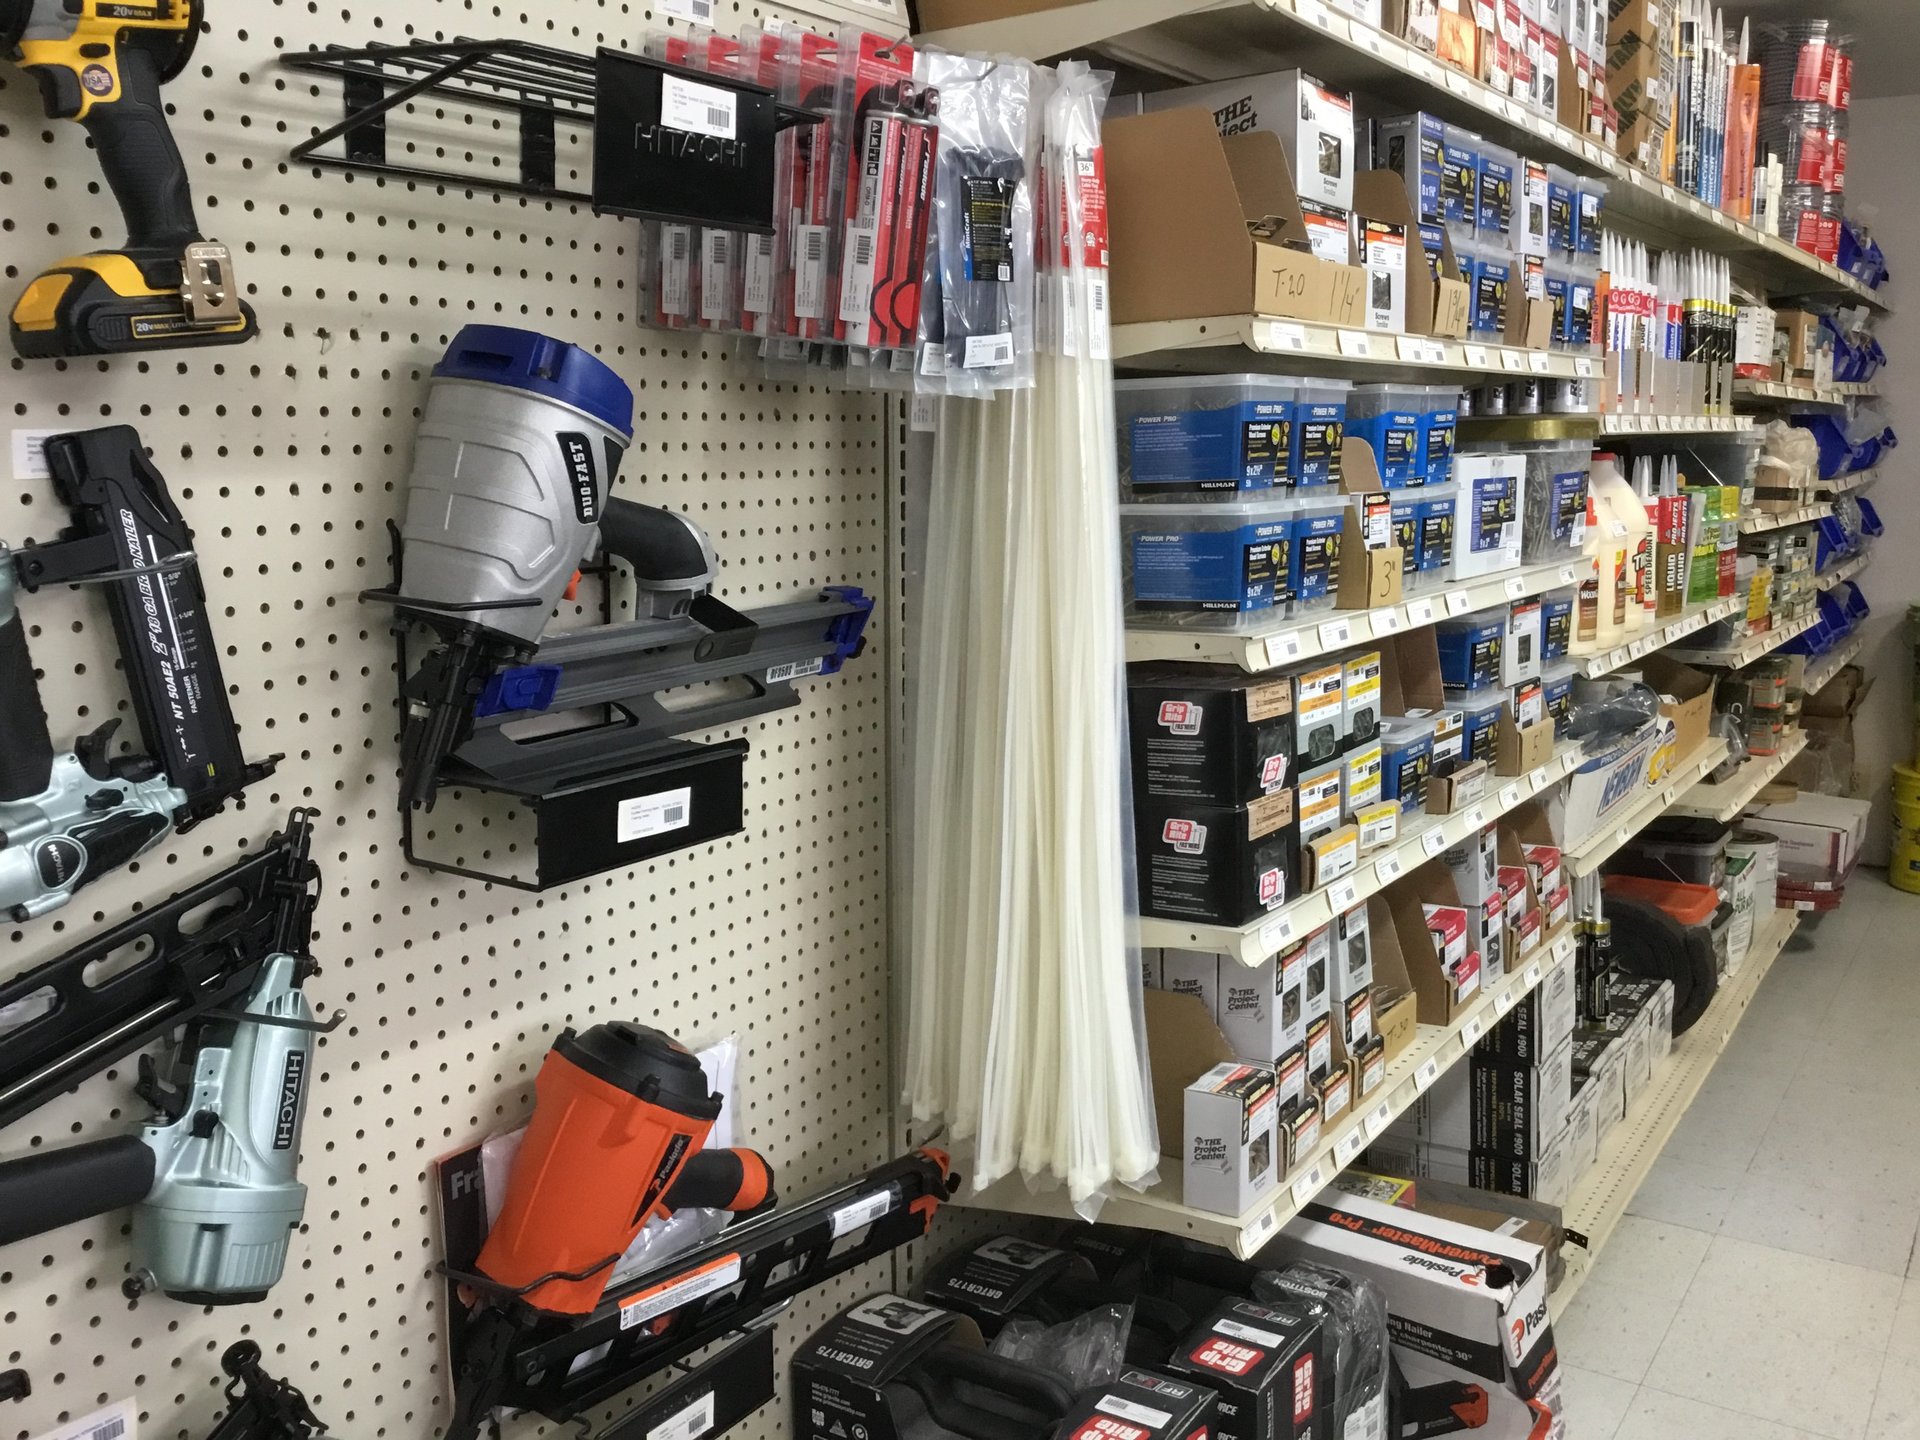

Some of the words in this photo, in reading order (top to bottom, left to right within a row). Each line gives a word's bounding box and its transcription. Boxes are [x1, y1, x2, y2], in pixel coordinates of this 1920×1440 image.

[86, 74, 102, 84] USA
[1213, 95, 1253, 127] THE
[1424, 116, 1434, 126] POWER
[1434, 120, 1442, 128] PRO
[634, 122, 747, 168] HITACHI
[1450, 148, 1461, 158] POWER
[1461, 152, 1470, 161] PRO
[1420, 230, 1430, 239] POWER
[1430, 232, 1440, 241] PRO
[1257, 405, 1272, 414] POWER
[1273, 404, 1282, 414] PRO
[1313, 407, 1327, 416] POWER
[1327, 407, 1337, 416] PRO
[1139, 416, 1162, 424] POWER
[1201, 481, 1235, 489] HILLMAN
[1257, 526, 1273, 537] POWER
[1272, 525, 1283, 535] PRO
[1312, 520, 1327, 529] POWER
[1327, 519, 1336, 528] PRO
[1671, 501, 1679, 546] PROJECTS
[120, 509, 141, 560] NAILER
[133, 557, 152, 595] BRD
[1666, 554, 1676, 592] LIQUID
[1677, 552, 1685, 590] LIQUID
[144, 596, 160, 617] GA
[148, 617, 162, 634] 18
[161, 660, 179, 700] 50AE2
[190, 673, 202, 700] RANGE
[182, 675, 198, 714] FASTENER
[173, 702, 184, 720] NT
[1164, 712, 1183, 722] Rite
[1166, 704, 1185, 714] Grip
[1268, 758, 1280, 770] Grip
[1168, 830, 1187, 840] Rite
[1170, 821, 1189, 832] Grip
[48, 844, 65, 883] HITACHI
[1263, 873, 1276, 887] Grip
[1182, 979, 1198, 987] THE
[1238, 988, 1255, 996] THE
[1227, 994, 1260, 1004] Project
[1227, 1003, 1260, 1011] Center
[1517, 1006, 1528, 1031] SEAL
[1513, 1070, 1524, 1103] SOLAR
[277, 1055, 302, 1145] HITACHI
[1513, 1104, 1524, 1130] SEAL
[1194, 1145, 1227, 1154] Project
[1204, 1138, 1222, 1146] THE
[1513, 1133, 1524, 1156] #900
[1194, 1152, 1226, 1161] Center
[1511, 1162, 1522, 1193] SOLAR
[1329, 1212, 1364, 1232] Pro
[1371, 1227, 1504, 1266] PowerMaster
[1402, 1254, 1465, 1278] Paslode
[948, 1277, 1003, 1300] GRTCR175
[1273, 1278, 1329, 1299] BOSTITCH
[1404, 1322, 1433, 1339] Nailer
[815, 1344, 875, 1370] GRTCR175
[1199, 1350, 1247, 1372] Grip
[1212, 1340, 1257, 1361] Rite
[1294, 1366, 1304, 1416] Rite
[1303, 1359, 1313, 1410] Grip
[1094, 1418, 1143, 1439] Rite
